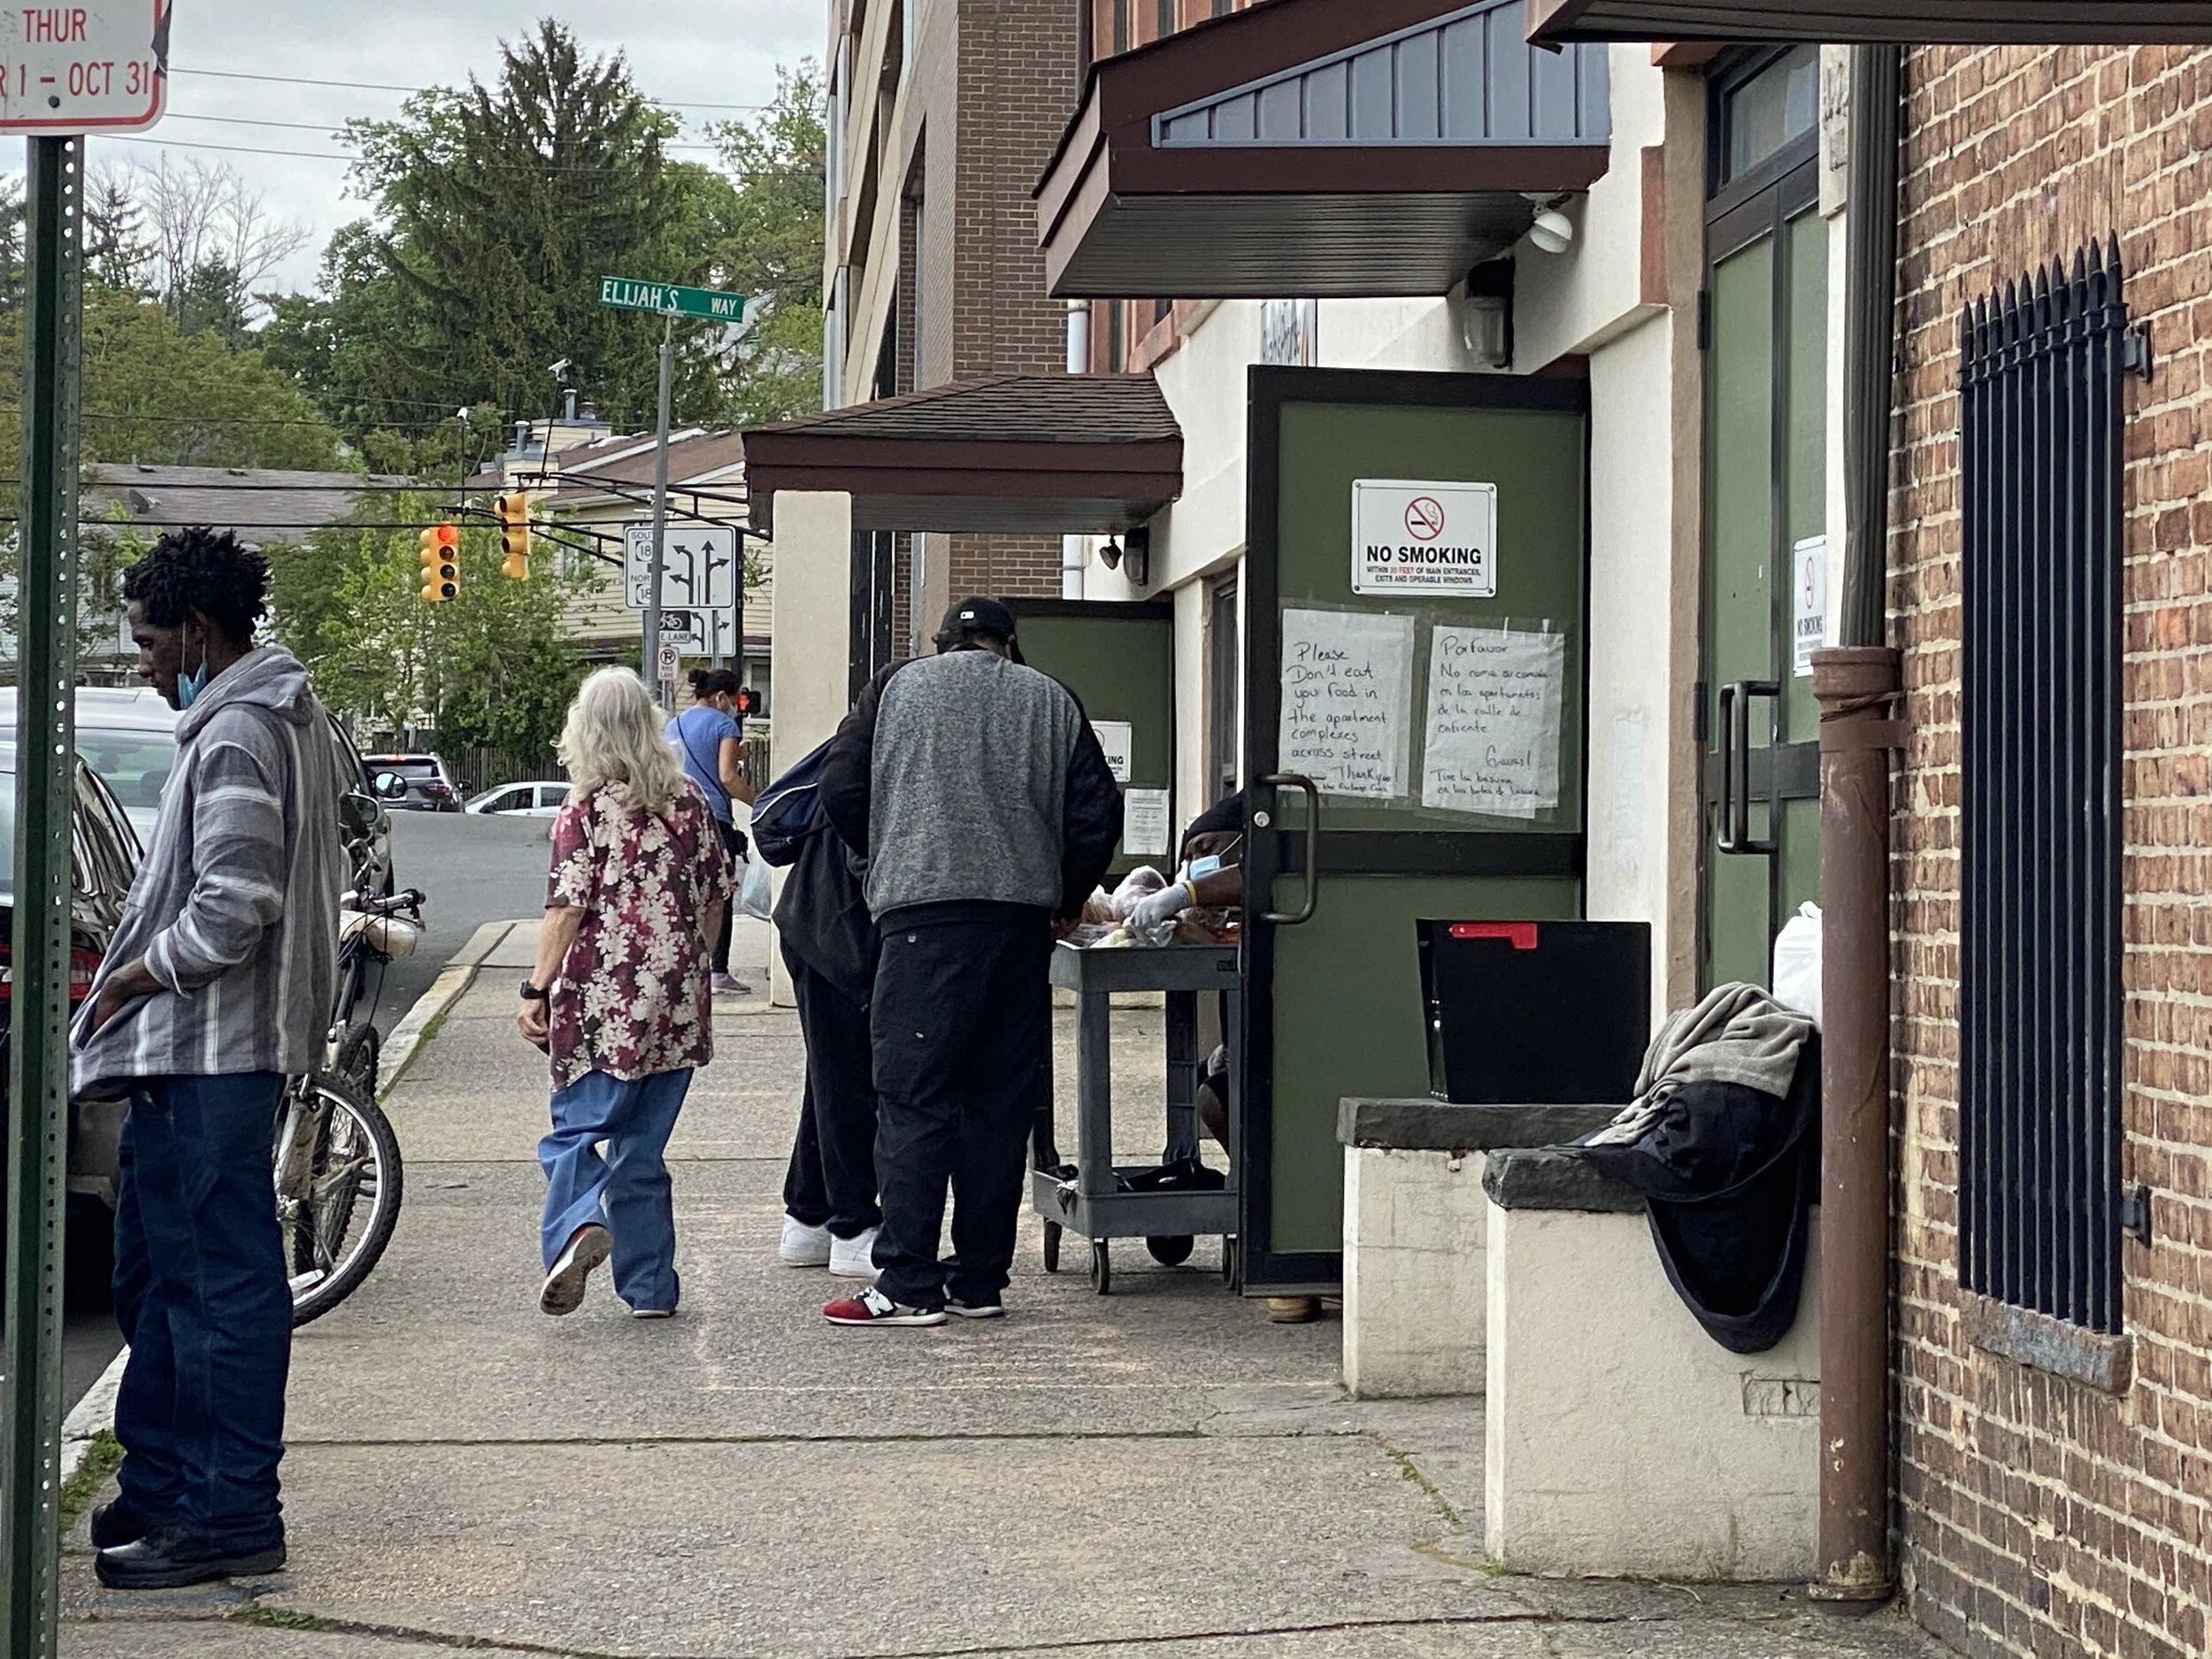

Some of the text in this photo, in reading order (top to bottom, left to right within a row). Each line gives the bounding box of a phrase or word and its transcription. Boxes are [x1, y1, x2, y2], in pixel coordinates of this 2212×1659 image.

[22, 9, 87, 42] THUR
[19, 64, 26, 97] 1
[69, 62, 114, 96] OCT
[126, 61, 149, 96] 31
[602, 280, 737, 316] ELIJAH'S WAY
[631, 531, 653, 540] SOU
[641, 545, 651, 557] 18
[1367, 545, 1481, 565] NO SMOKING
[630, 574, 651, 583] NOR
[1409, 575, 1441, 584] OPERABLE
[1294, 641, 1349, 661] Please
[1440, 634, 1469, 656] Por
[1286, 661, 1373, 684] Don't eat
[1440, 663, 1461, 678] No
[1294, 687, 1319, 709] you
[1364, 687, 1378, 700] in
[1288, 708, 1317, 725] the
[1291, 726, 1358, 743] complexes
[1291, 747, 1384, 762] across street
[1330, 764, 1373, 781] Thank
